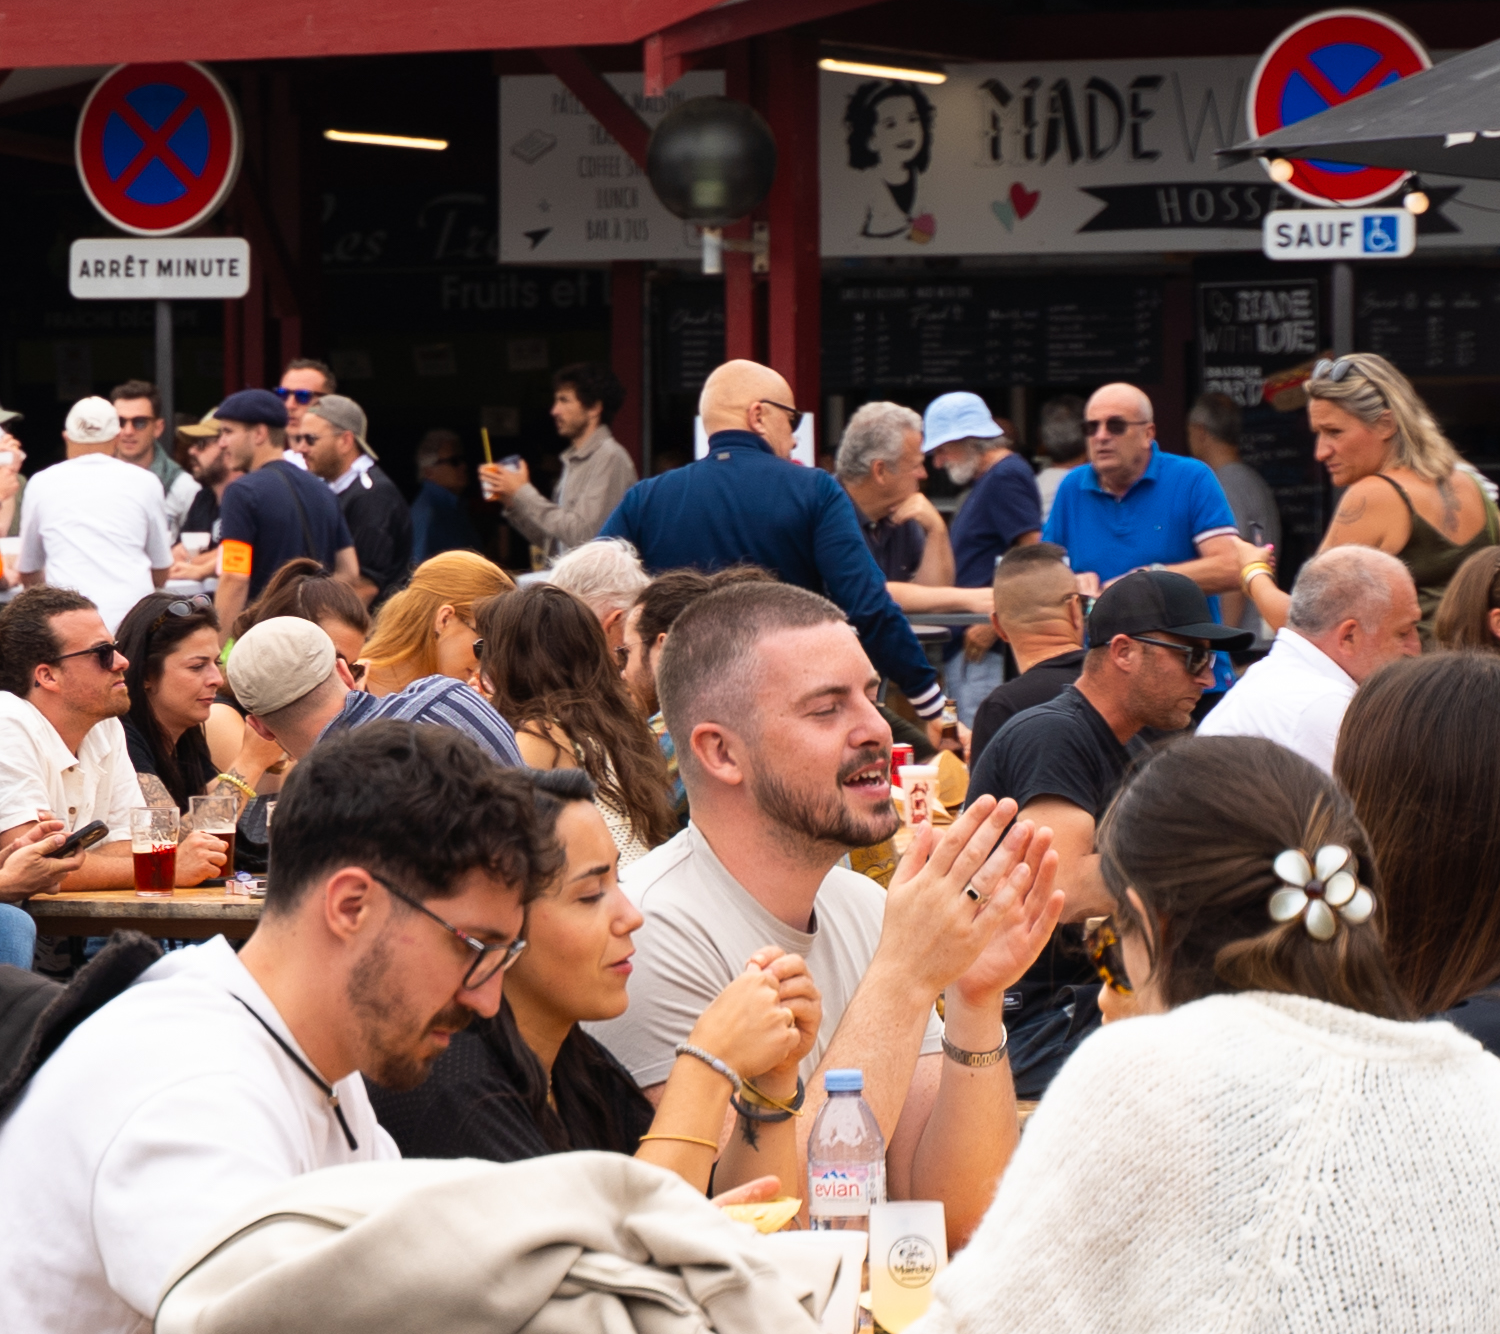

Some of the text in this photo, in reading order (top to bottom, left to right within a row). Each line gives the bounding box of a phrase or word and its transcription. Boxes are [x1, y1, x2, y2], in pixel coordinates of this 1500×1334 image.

[979, 74, 1163, 164] MADE
[1156, 186, 1291, 225] HOSSE
[1275, 223, 1354, 248] SAUF
[79, 255, 240, 278] ARRÊT MINUTE
[441, 275, 589, 310] Fruits et
[815, 1181, 860, 1198] evian
